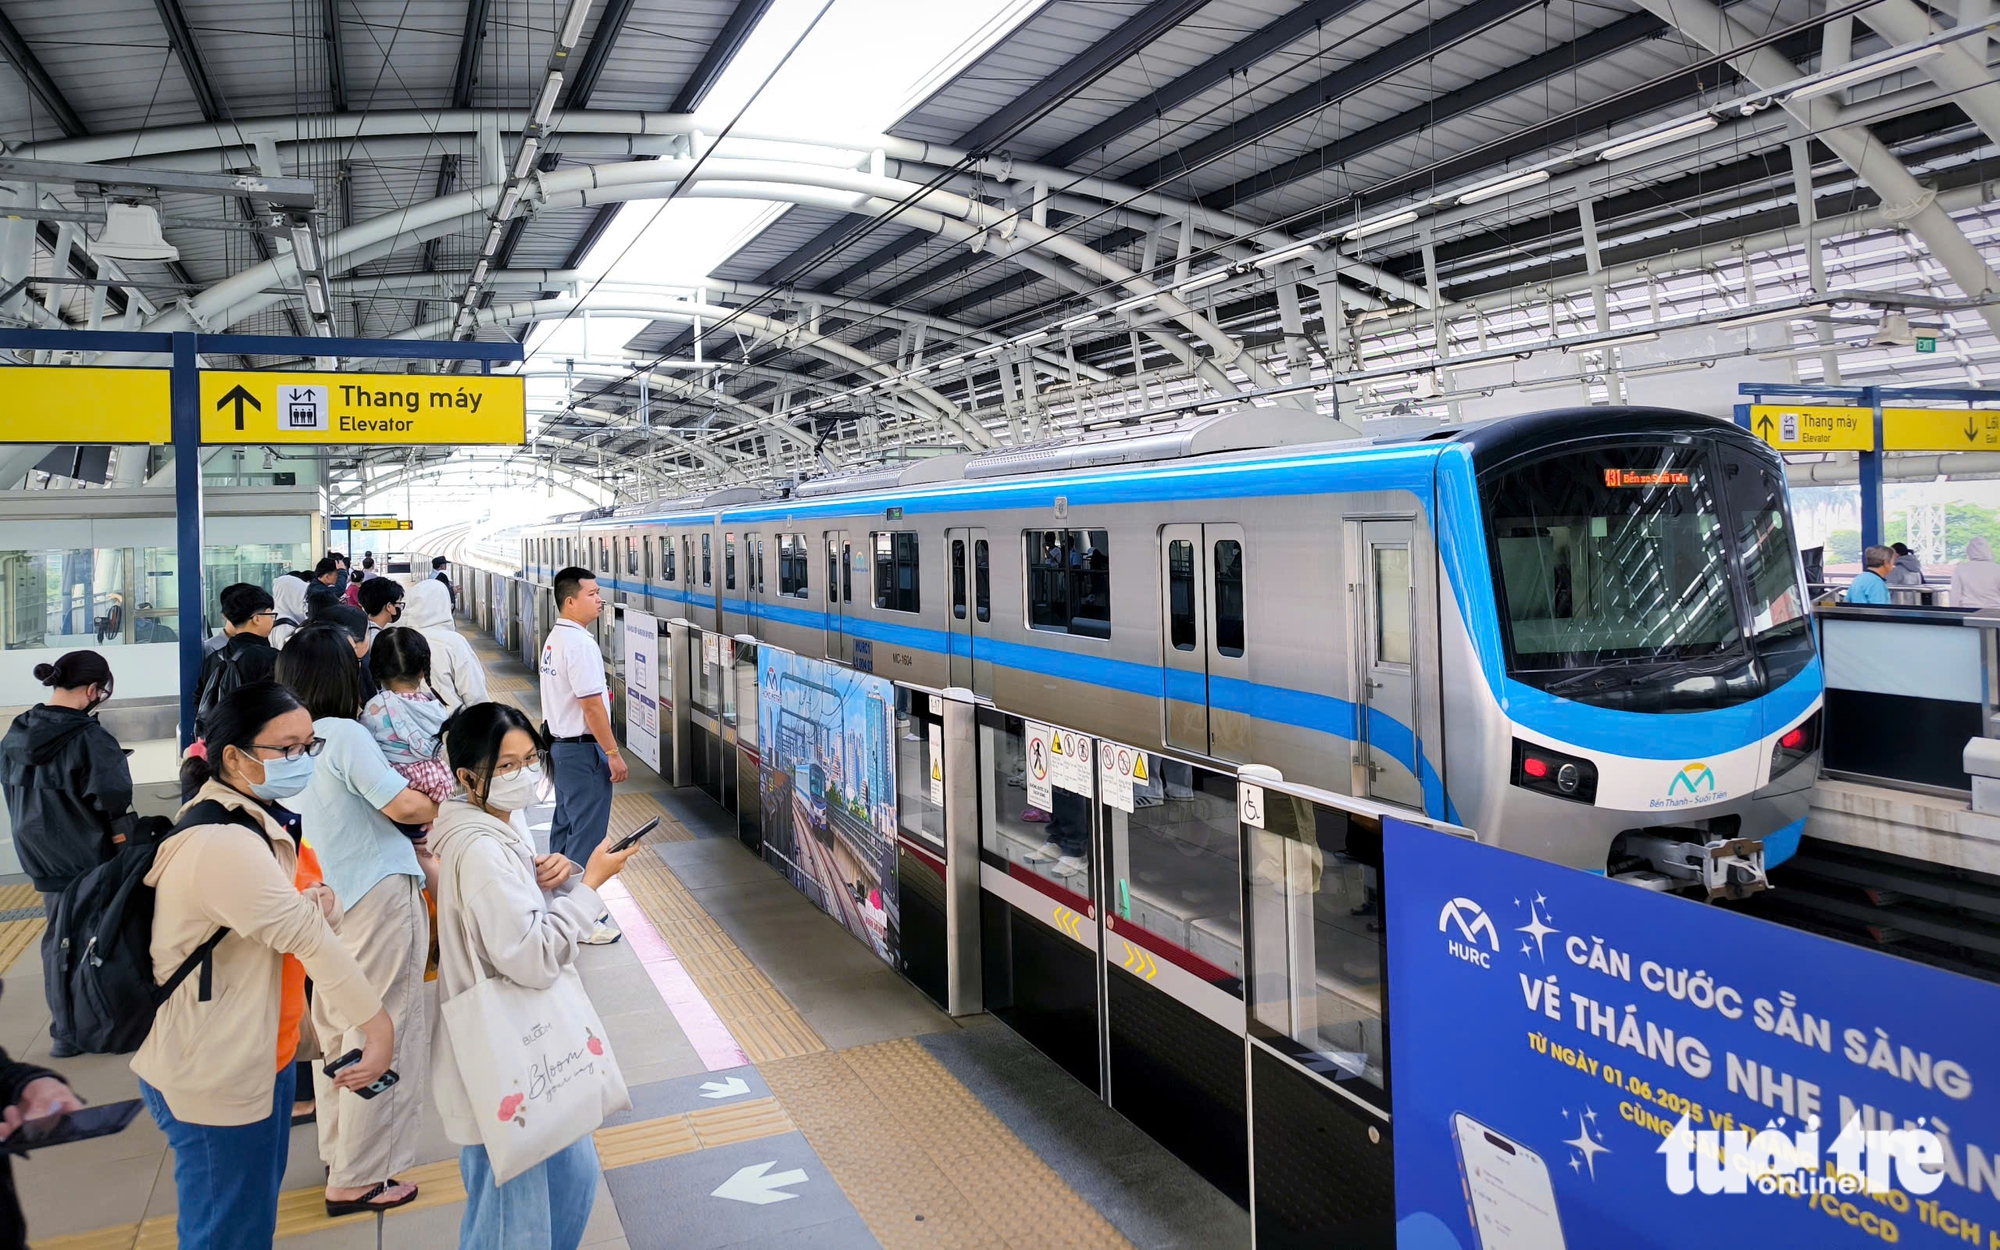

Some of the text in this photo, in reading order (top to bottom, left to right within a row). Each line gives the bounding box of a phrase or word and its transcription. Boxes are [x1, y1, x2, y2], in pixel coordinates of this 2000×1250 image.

[338, 385, 483, 413] Thang máy
[339, 416, 414, 431] Elevator
[1802, 413, 1858, 430] Thang máy
[1802, 434, 1831, 443] Elevator
[1448, 940, 1491, 969] HURC
[1519, 972, 1561, 1021] VÉ
[1570, 992, 1712, 1079] THÁNG
[1565, 935, 1973, 1099] CĂN CƯỚC SẴN SÀNG
[529, 1048, 584, 1100] Bloom
[1618, 1101, 1676, 1139] CÙNG
[1528, 1031, 1548, 1054] TỪ
[1551, 1042, 1600, 1077] NGÀY
[1603, 1065, 1704, 1123] 01.06.2025
[1915, 1198, 1981, 1246] TÍCH
